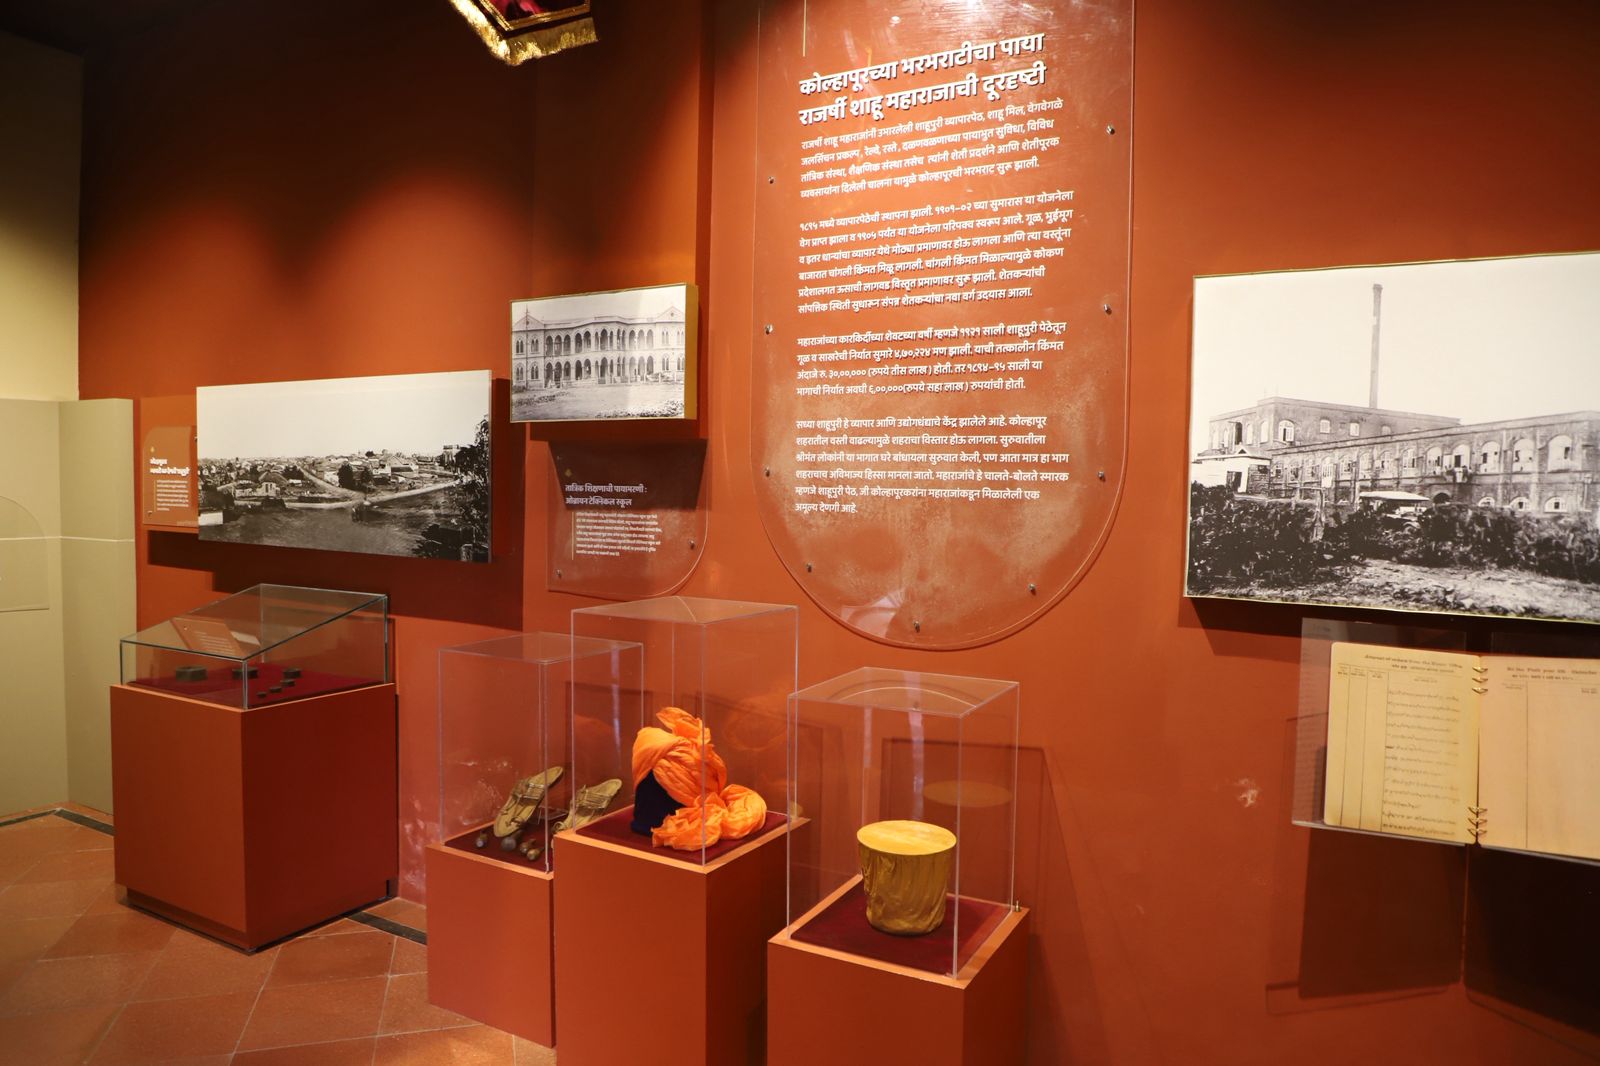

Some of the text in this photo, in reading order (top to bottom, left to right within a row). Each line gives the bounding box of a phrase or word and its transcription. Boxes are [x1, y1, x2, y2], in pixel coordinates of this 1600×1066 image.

[799, 33, 1044, 94] कोल्हापूरच्या भरभराटीचा पाया
[798, 96, 848, 125] राजर्षी
[850, 96, 885, 120] शाहू
[886, 73, 979, 109] महाराजाची
[801, 137, 822, 149] राजर्षी
[824, 136, 839, 148] शाहू
[878, 121, 913, 137] उभारलेली
[915, 117, 942, 133] शाहूपुरी
[944, 112, 985, 126] व्यापारपेठ,
[987, 109, 1004, 122] शाहू
[1005, 105, 1026, 117] मिल,
[1027, 98, 1063, 113] वेगवेगळे
[996, 118, 1054, 139] सुविधा, विविध
[826, 137, 1060, 178] संस्था, संस्था तसेच त्यांनी शेती प्रदर्शने आणि शेतीपूरक
[841, 156, 1039, 193] दिलेली चालना यामुळे कोल्हापूरची भरभराट झाली.
[836, 211, 880, 226] व्यापारपेठेची
[910, 205, 933, 219] झाली.
[974, 201, 988, 210] च्या
[990, 197, 1023, 212] सुमारास
[1024, 196, 1034, 204] या
[1036, 190, 1074, 203] योजनेला
[800, 238, 810, 247] वेग
[829, 234, 848, 246] झाला
[857, 232, 876, 240] १९०५
[897, 228, 907, 236] या
[908, 223, 941, 235] योजनेला
[1003, 213, 1024, 225] आले.
[852, 231, 1041, 258] व्यापार येथे प्रमाणावर होऊ लागला आणि त्या
[829, 265, 852, 277] चांगली
[854, 264, 876, 275] किंमत
[895, 258, 923, 271] लागली.
[925, 256, 951, 268] चांगली
[953, 254, 978, 266] किंमत
[980, 248, 1032, 264] मिळाल्यामुळे
[1033, 247, 1064, 259] कोकण
[863, 281, 890, 291] लागवड
[917, 276, 954, 287] प्रमाणावर
[972, 269, 997, 284] झाली.
[946, 293, 960, 302] नवा
[963, 289, 976, 300] वर्ग
[977, 289, 1006, 300] उदयास
[1008, 288, 1033, 297] आला.
[885, 321, 1067, 341] शेवटच्या वर्षी म्हणजे १९२१ साली शाहूपुरी पेठेतून
[818, 350, 847, 362] साखरेची
[873, 348, 893, 362] सुमारे
[932, 347, 946, 356] मण
[948, 343, 972, 356] झाली.
[975, 342, 994, 354] याची
[996, 340, 1036, 353] तत्कालीन
[1037, 339, 1064, 351] किंमत
[797, 368, 818, 380] अंदाजे
[890, 364, 907, 375] तीस
[933, 362, 953, 374] होती.
[1007, 359, 1030, 370] साली
[1032, 361, 1043, 370] या
[797, 385, 821, 396] भागाची
[970, 378, 1003, 390] रुपयांची
[1005, 377, 1026, 390] होती.
[817, 418, 842, 432] शाहूपुरी
[843, 418, 849, 429] हे
[876, 417, 896, 427] आणि
[959, 415, 986, 428] झालेले
[988, 415, 1007, 426] आहे.
[1009, 415, 1047, 429] कोल्हापूर
[796, 435, 829, 446] शहरातील
[830, 434, 848, 445] वस्ती
[892, 436, 920, 445] शहराचा
[922, 434, 948, 444] विस्तार
[950, 434, 966, 445] होऊ
[968, 436, 998, 444] लागला.
[817, 452, 845, 462] लोकांनी
[880, 452, 891, 462] घरे
[893, 452, 927, 462] बांधायला
[960, 451, 982, 463] केली,
[983, 454, 998, 462] पण
[1000, 454, 1020, 462] आता
[1022, 454, 1038, 462] मात्र
[1040, 454, 1050, 464] हा
[1052, 454, 1070, 463] भाग
[865, 468, 886, 480] हिस्सा
[888, 471, 912, 479] मानला
[913, 469, 934, 480] जातो.
[936, 469, 975, 481] महाराजांचे
[1040, 473, 1069, 482] स्मारक
[795, 485, 1040, 501] म्हणजे शाहूपुरी पेठ, कोल्हापूरकरांना महाराजांकडून मिळालेली एक
[795, 502, 858, 514] अमूल्य देणगी आहे.
